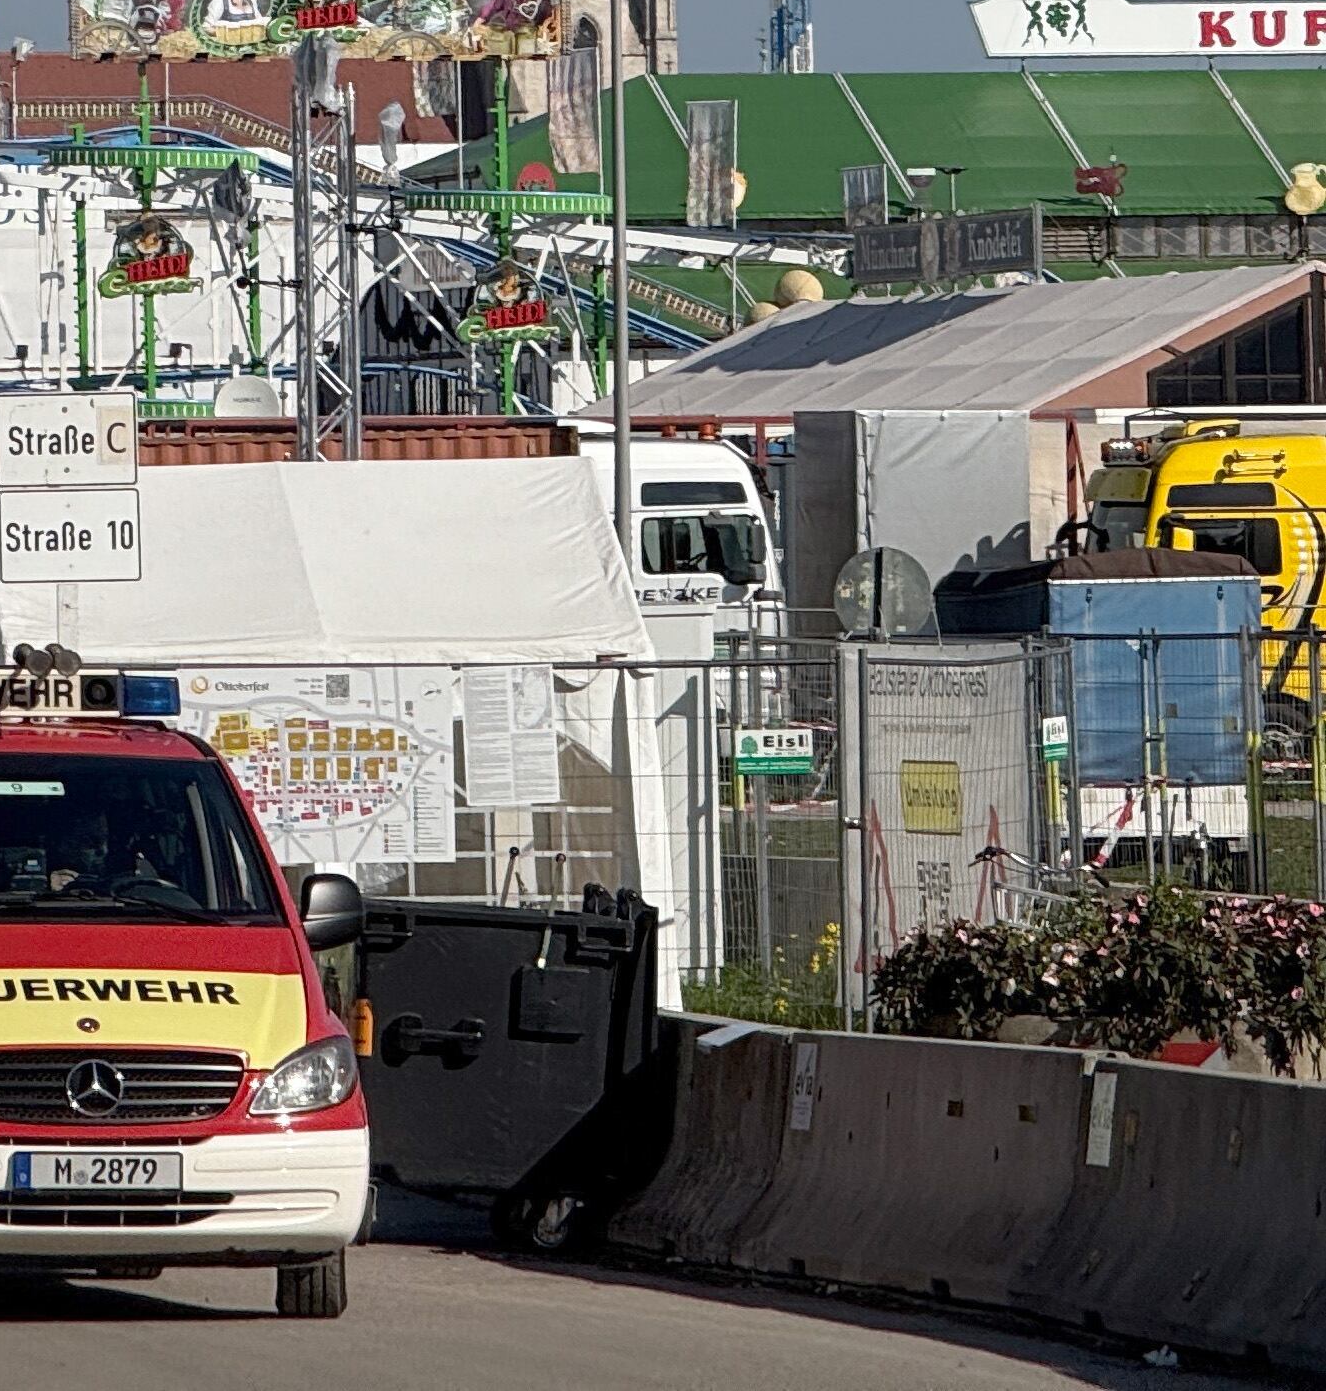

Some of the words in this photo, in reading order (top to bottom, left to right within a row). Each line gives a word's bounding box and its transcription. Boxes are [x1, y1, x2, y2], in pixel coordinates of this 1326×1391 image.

[297, 2, 357, 28] HEIDI
[128, 254, 189, 282] HEIDI
[486, 300, 547, 329] HEIDI
[8, 424, 95, 456] Straße
[107, 422, 127, 454] C
[5, 521, 92, 553] Straße
[107, 520, 134, 551] 10
[214, 681, 269, 693] Oktoberfest
[54, 1157, 72, 1185] M
[91, 1158, 158, 1185] 2879
